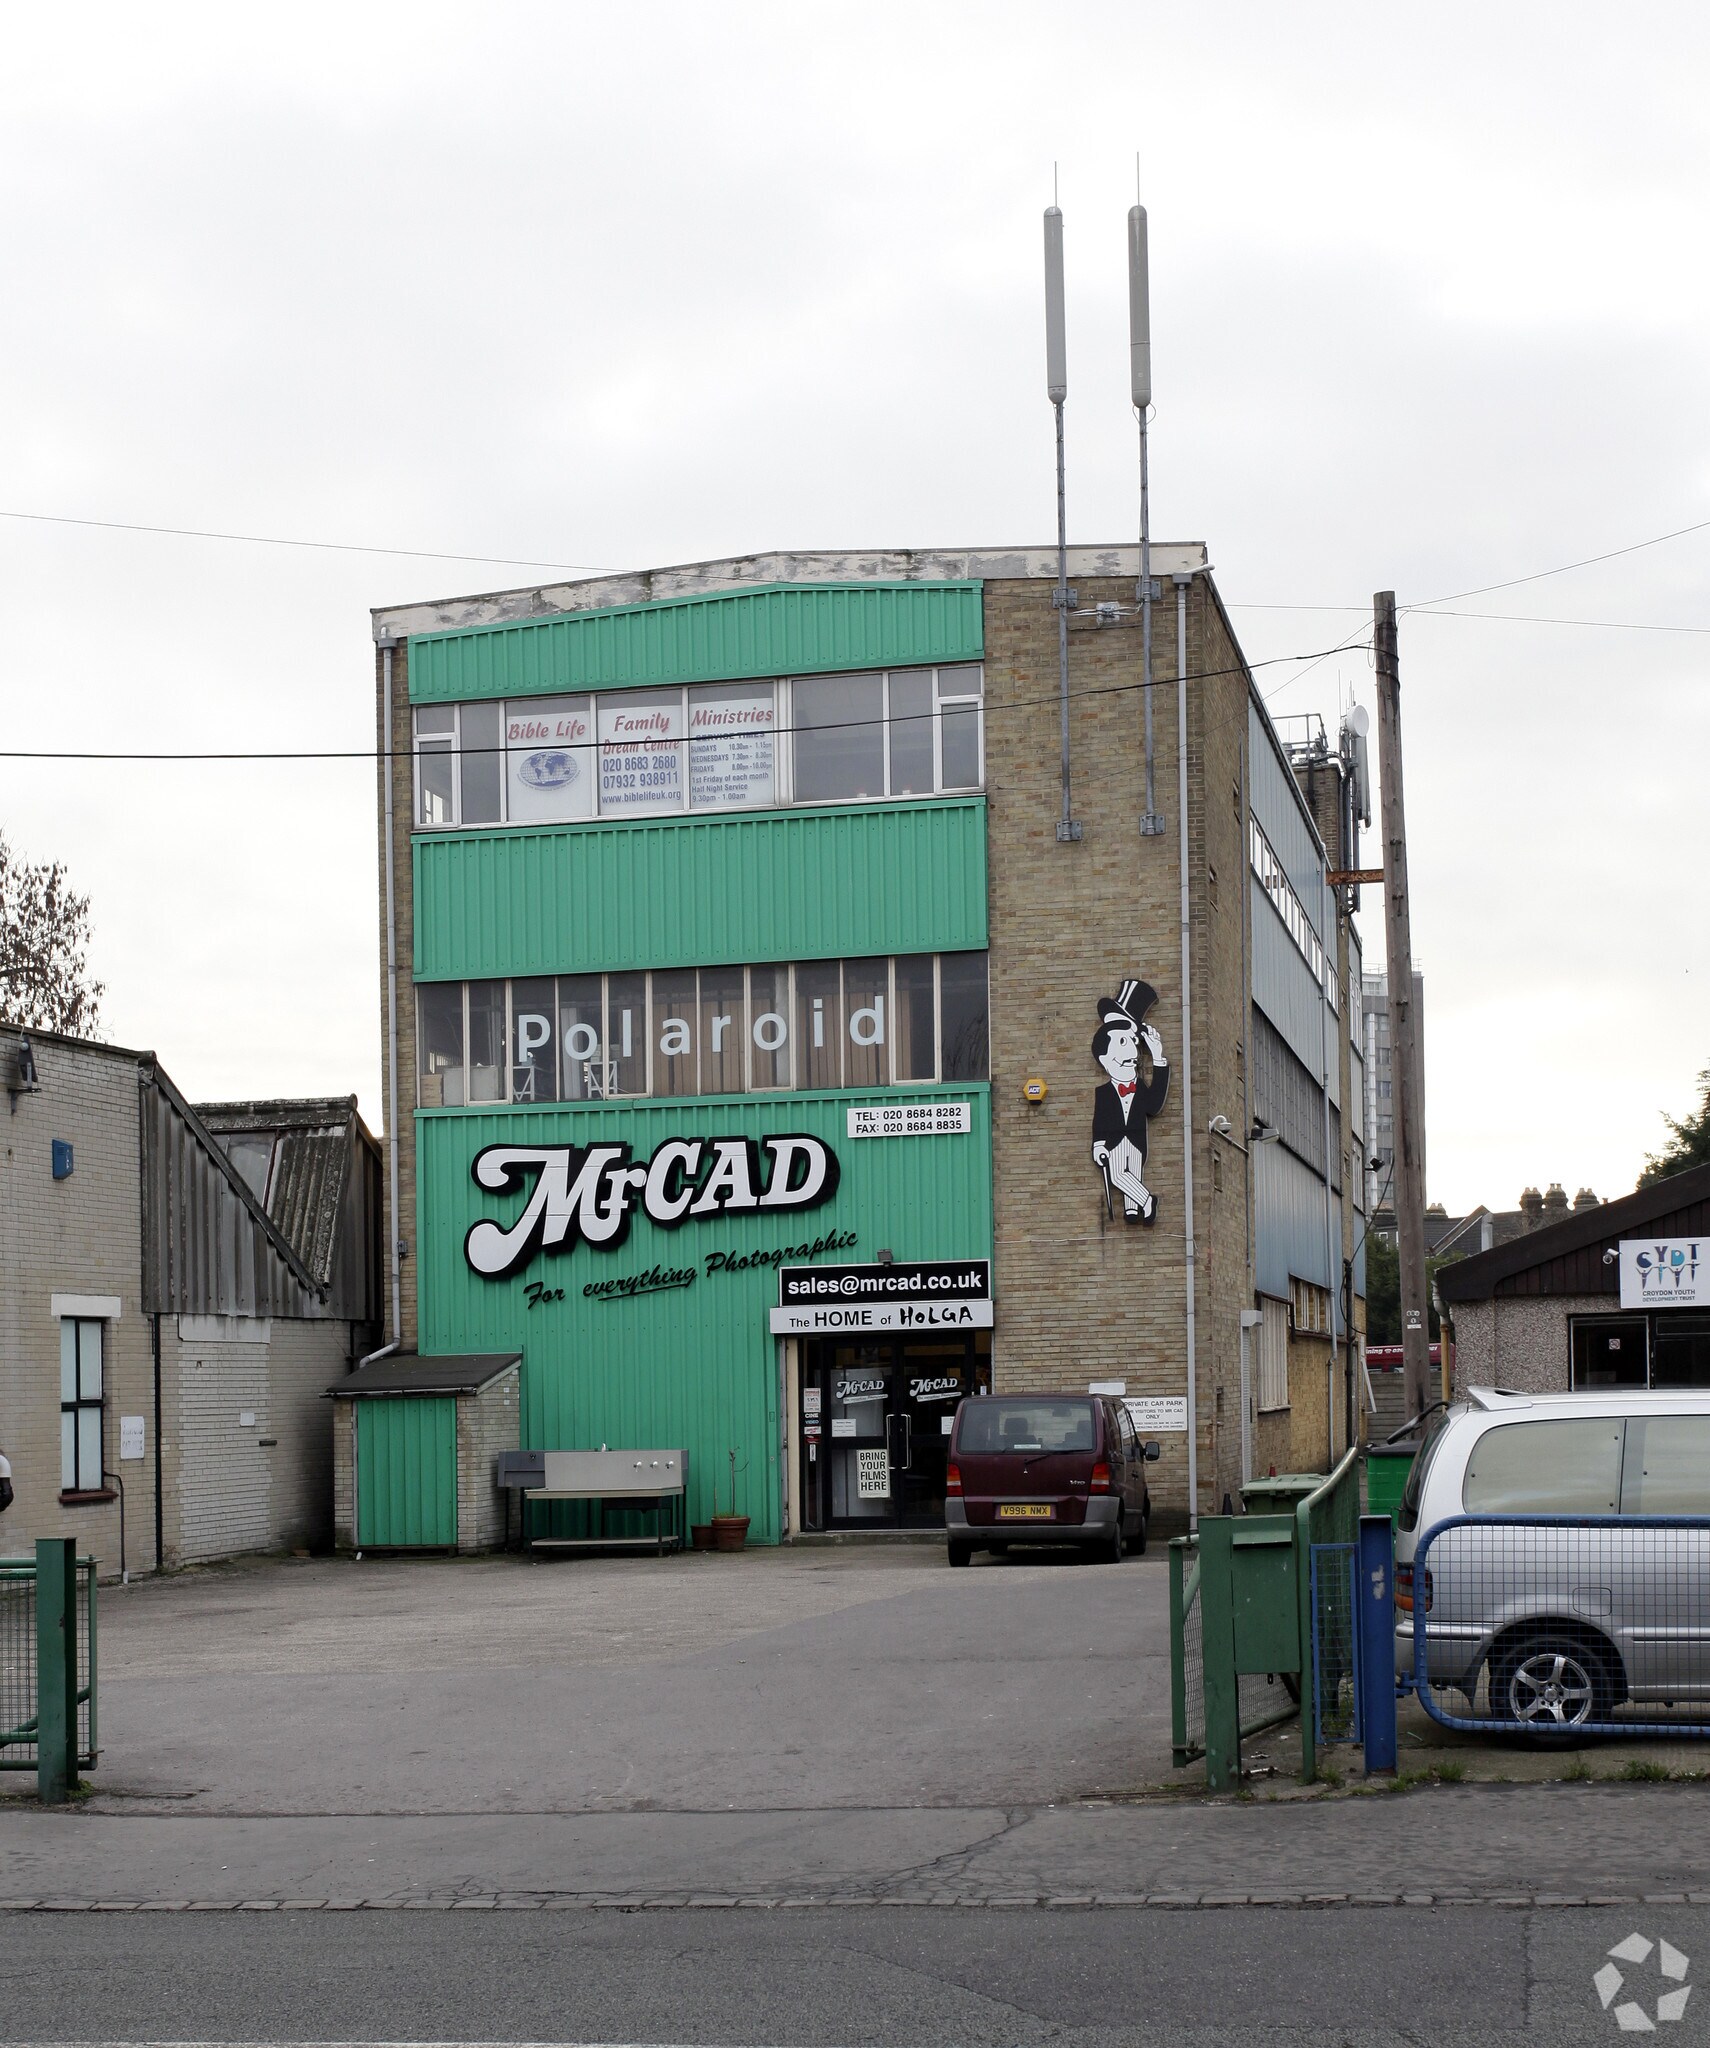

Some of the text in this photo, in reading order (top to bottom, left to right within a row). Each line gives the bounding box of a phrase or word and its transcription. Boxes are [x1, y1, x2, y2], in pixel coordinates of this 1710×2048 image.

[614, 712, 670, 733] Family
[691, 706, 773, 727] Ministries
[508, 719, 586, 740] Bible Life
[603, 735, 680, 755] Dream Centre
[690, 744, 717, 753] SUNDAYS
[603, 755, 676, 772] 020 8683 2680
[691, 753, 729, 763] WEDNESDAYS
[690, 765, 714, 773] FRIDAYS
[603, 771, 678, 789] 07932 938911
[703, 775, 723, 784] Friday
[732, 773, 747, 781] each
[749, 772, 769, 780] month
[706, 784, 723, 793] Night
[724, 783, 748, 791] Service
[602, 790, 681, 804] www.biblelifeuk.org
[518, 995, 885, 1063] Polaroid
[855, 1107, 961, 1121] TEL: 020 8684 8282
[856, 1120, 962, 1133] FAX: 020 8684 8835
[523, 1227, 859, 1310] For everything Photographic
[788, 1270, 982, 1295] sales@mrcad.co.uk
[1642, 1289, 1673, 1297] CROYDON
[789, 1318, 810, 1328] The
[814, 1310, 873, 1327] HOME
[880, 1315, 892, 1325] of
[860, 1451, 886, 1461] BRING
[860, 1461, 886, 1470] YOUR
[860, 1470, 887, 1480] FILMS
[861, 1481, 887, 1491] HERE
[1003, 1506, 1027, 1515] V996
